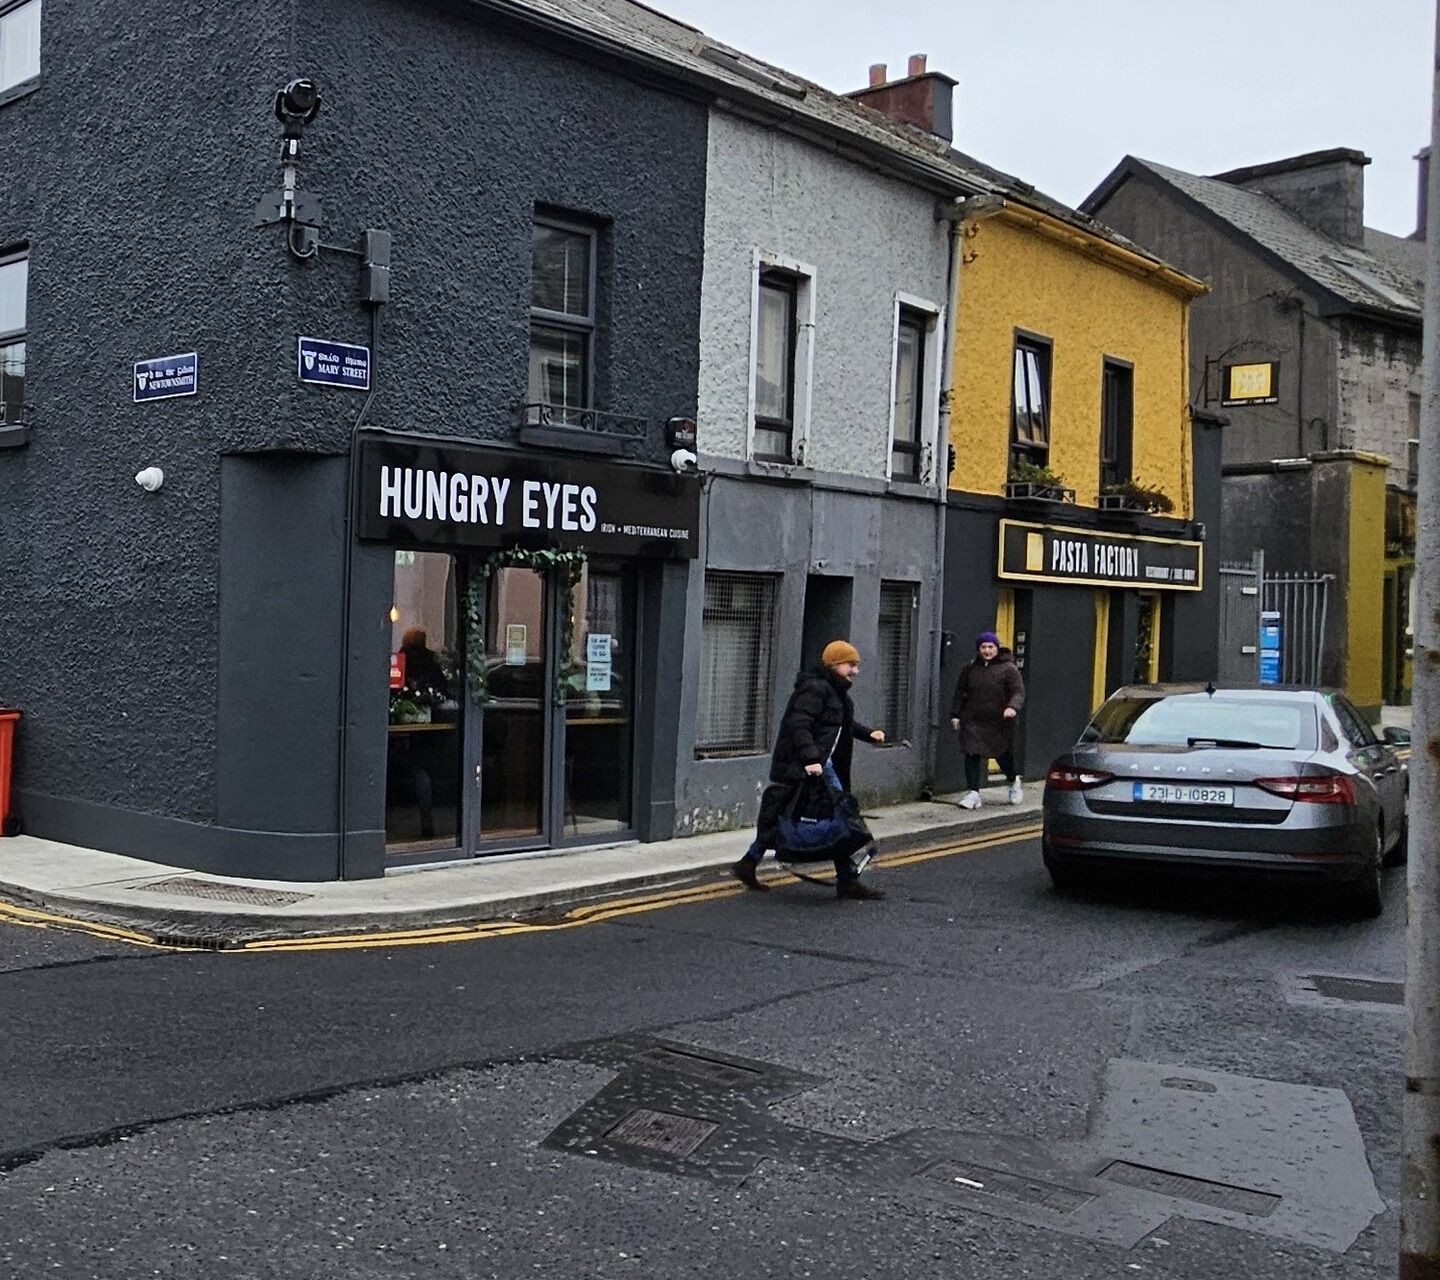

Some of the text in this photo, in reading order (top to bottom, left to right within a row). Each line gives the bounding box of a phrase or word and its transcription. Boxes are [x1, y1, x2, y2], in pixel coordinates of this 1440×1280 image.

[318, 363, 367, 380] MARY STREET
[380, 465, 597, 532] HUNGRY EYES
[623, 524, 668, 538] MEDITERRANEAN
[1051, 539, 1089, 574] PASTA
[1094, 544, 1139, 577] FACTORY
